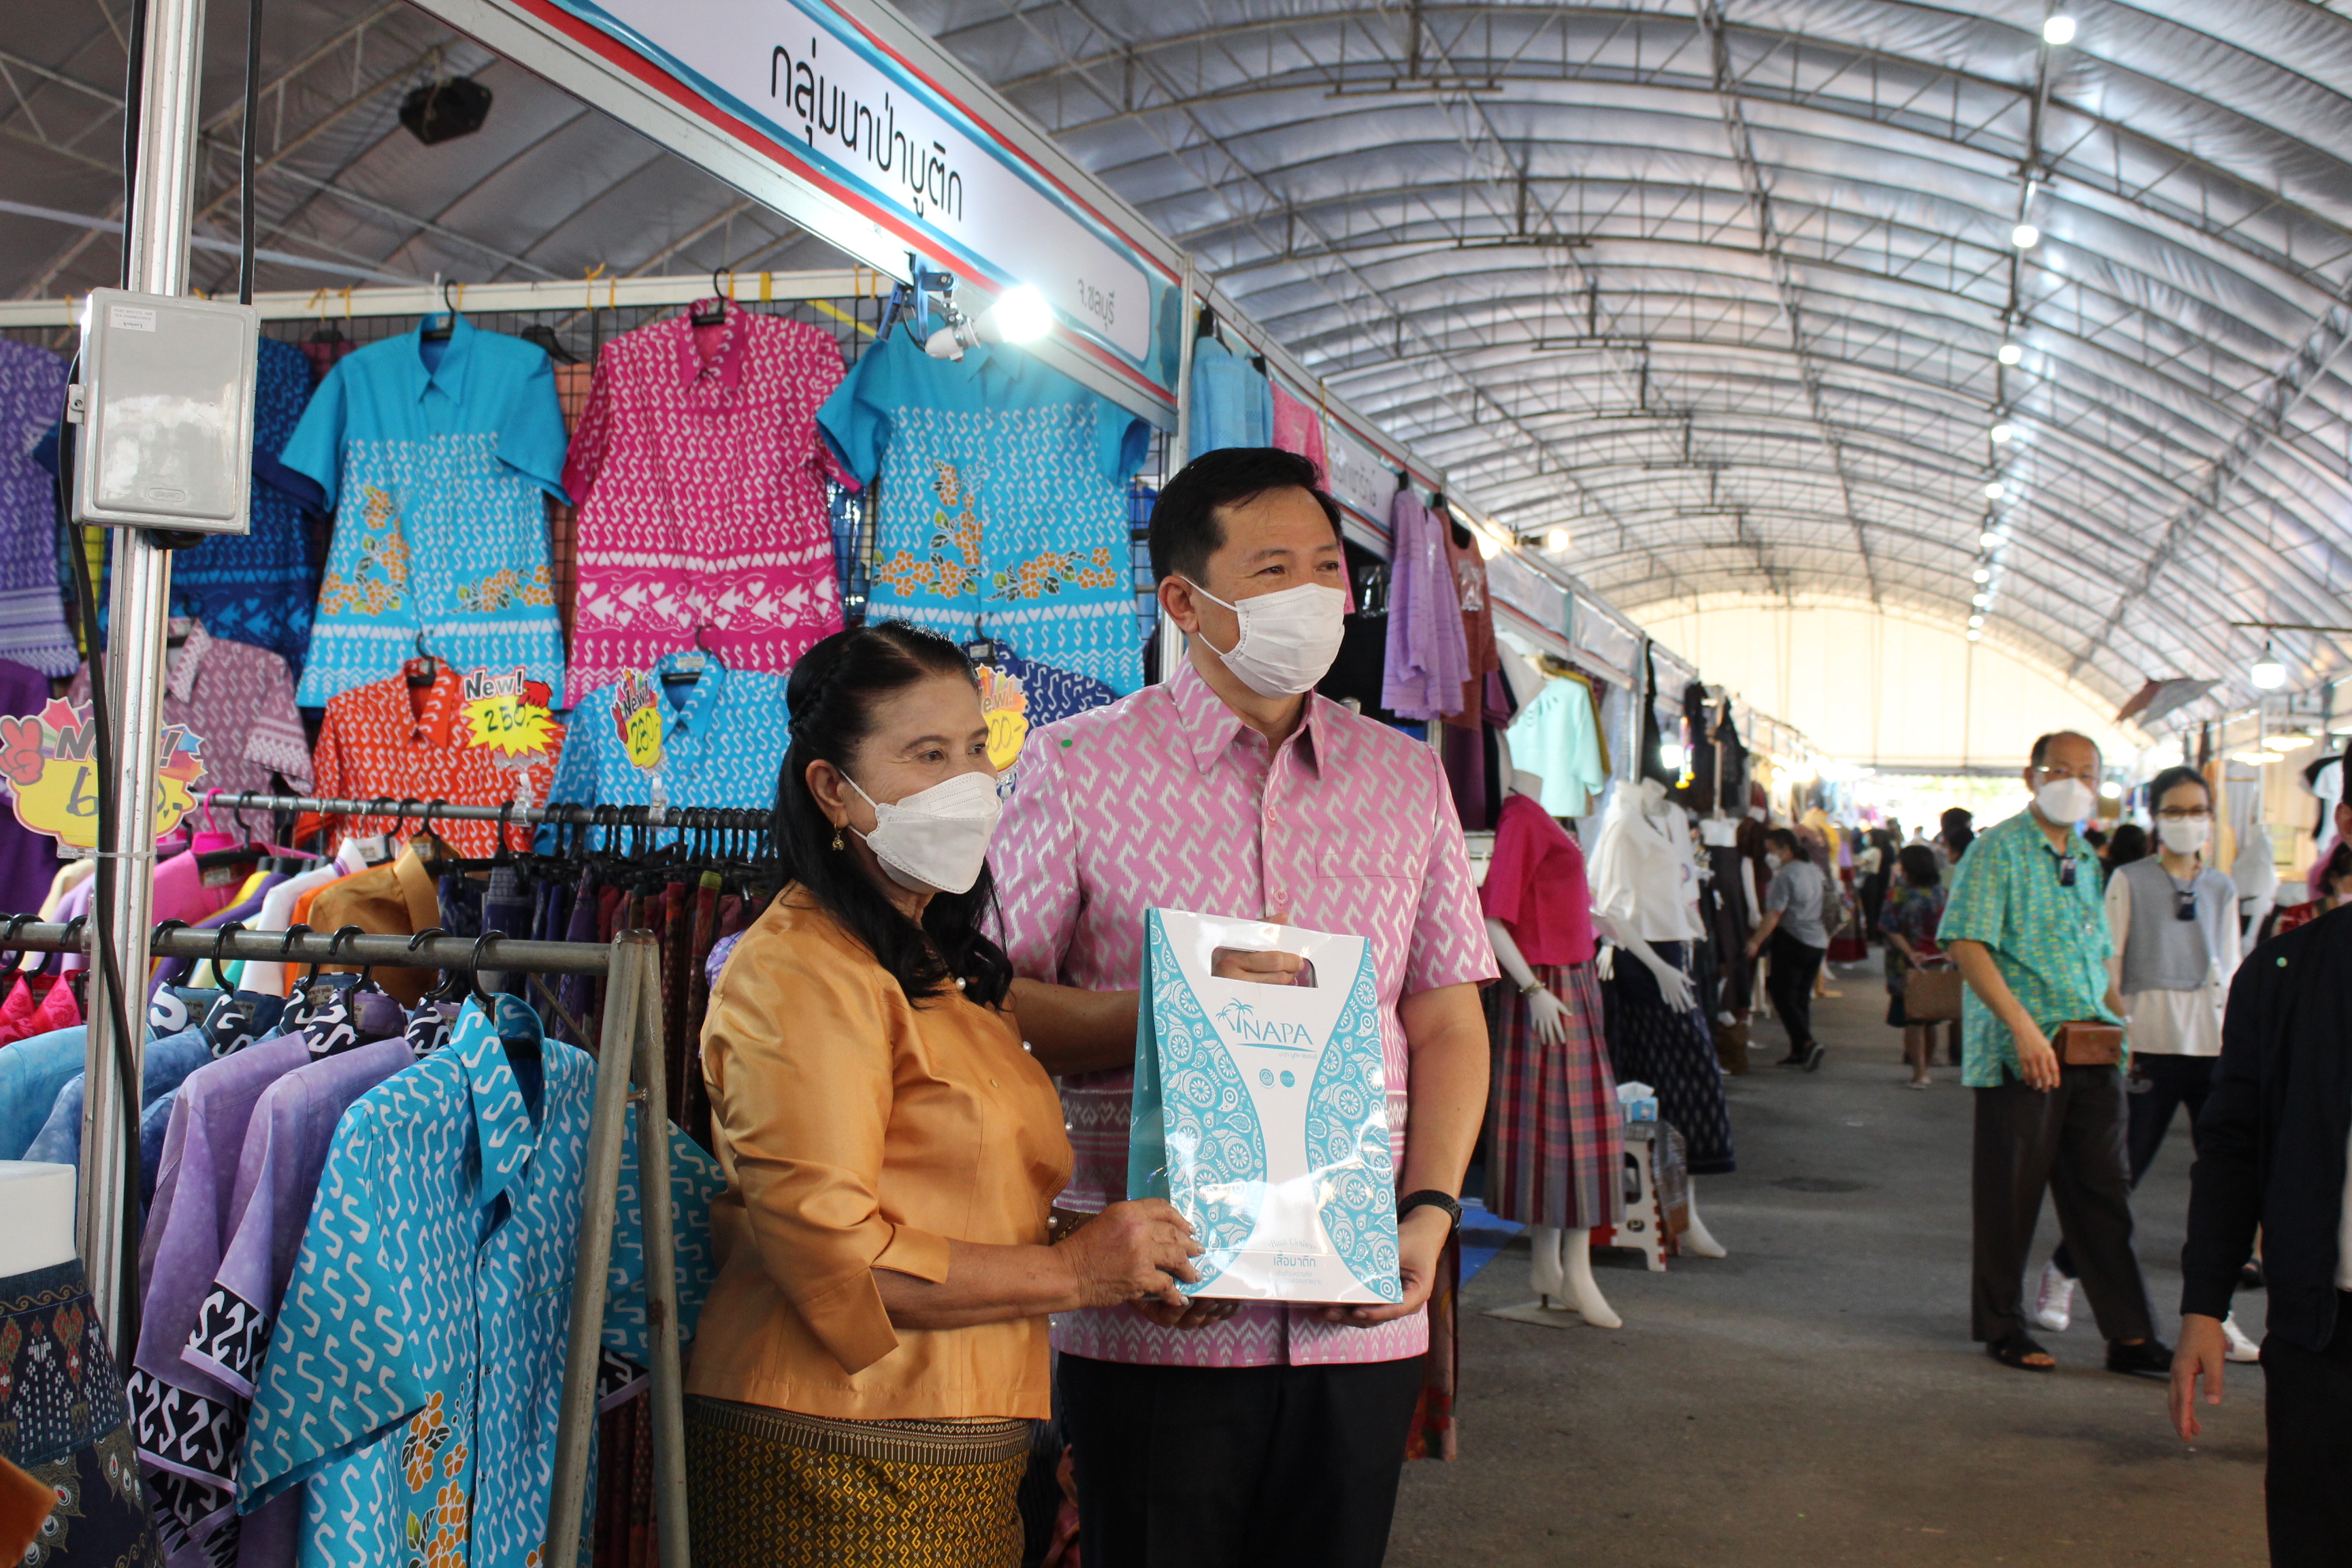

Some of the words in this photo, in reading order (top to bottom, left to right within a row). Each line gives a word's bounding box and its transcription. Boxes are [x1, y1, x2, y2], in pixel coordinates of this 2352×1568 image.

[770, 37, 963, 222] กลุ่มนาป่าบูติก
[1077, 278, 1115, 332] จ.ชลบุรี
[464, 669, 524, 700] New!
[623, 680, 651, 719] New!
[980, 681, 1014, 713] ew!
[1243, 1018, 1313, 1045] NAPA
